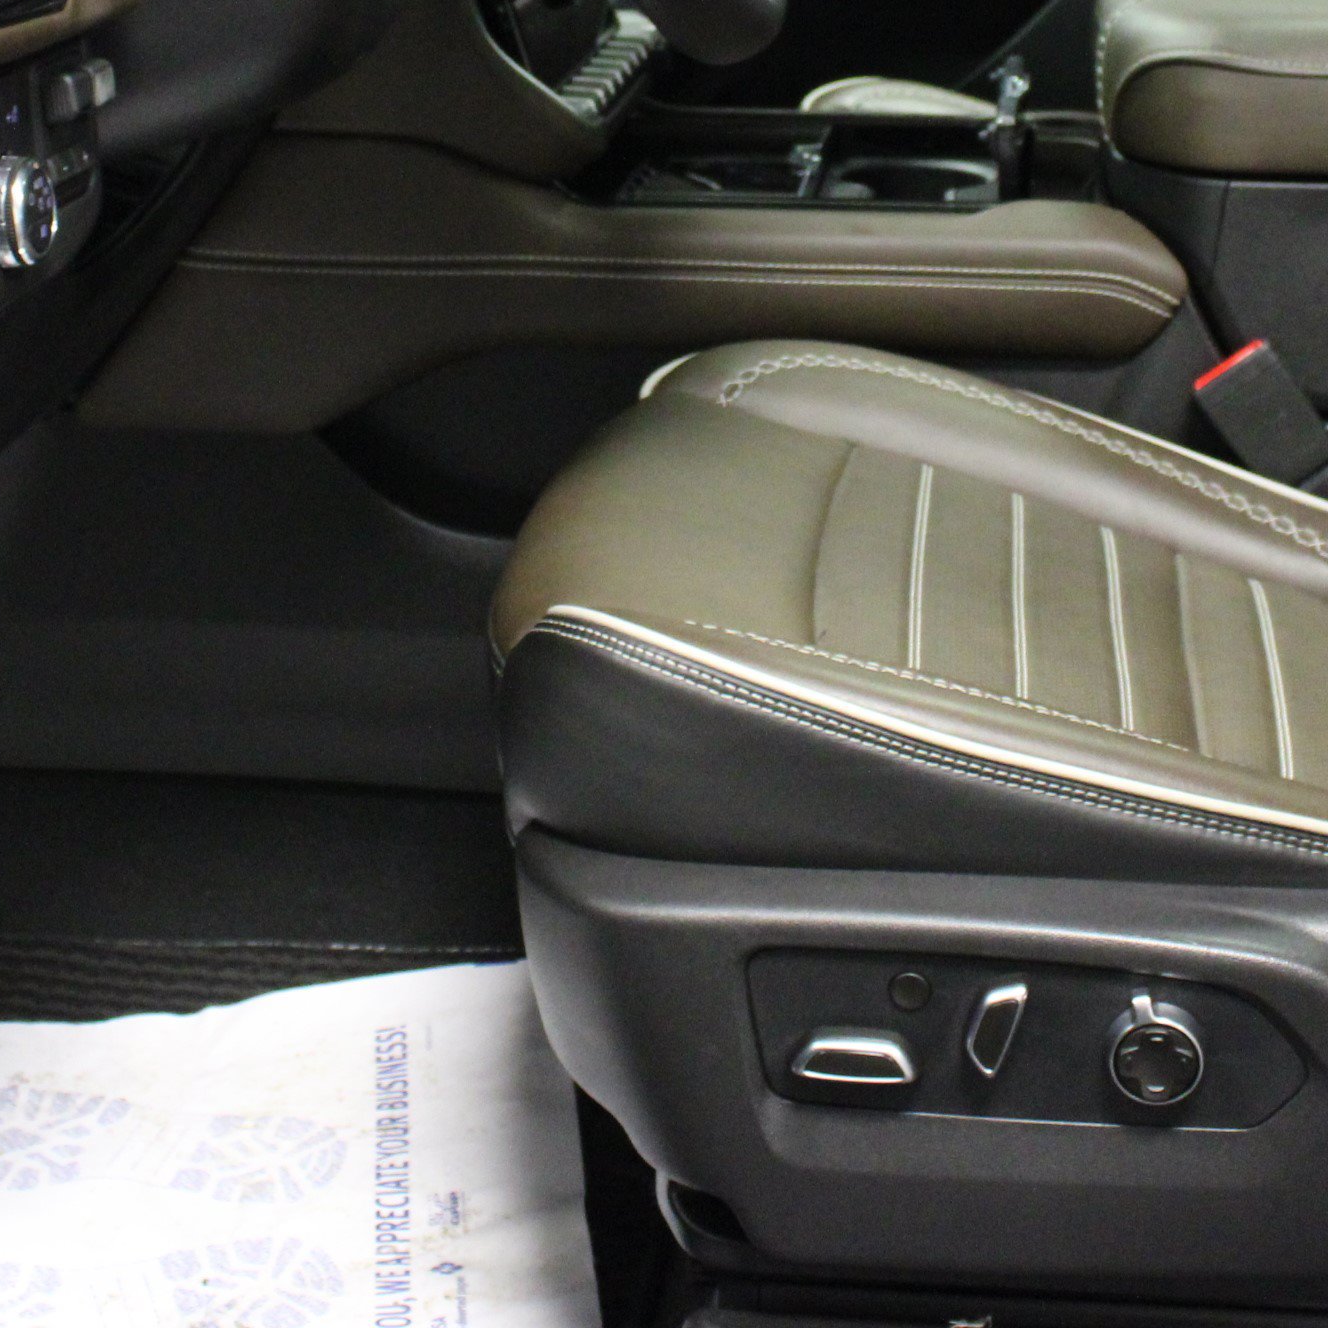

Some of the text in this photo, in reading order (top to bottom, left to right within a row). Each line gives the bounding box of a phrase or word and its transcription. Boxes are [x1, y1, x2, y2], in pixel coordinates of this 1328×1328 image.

[374, 1025, 418, 1328] OU, WE APPRECIATE YOUR BUSINESS!
